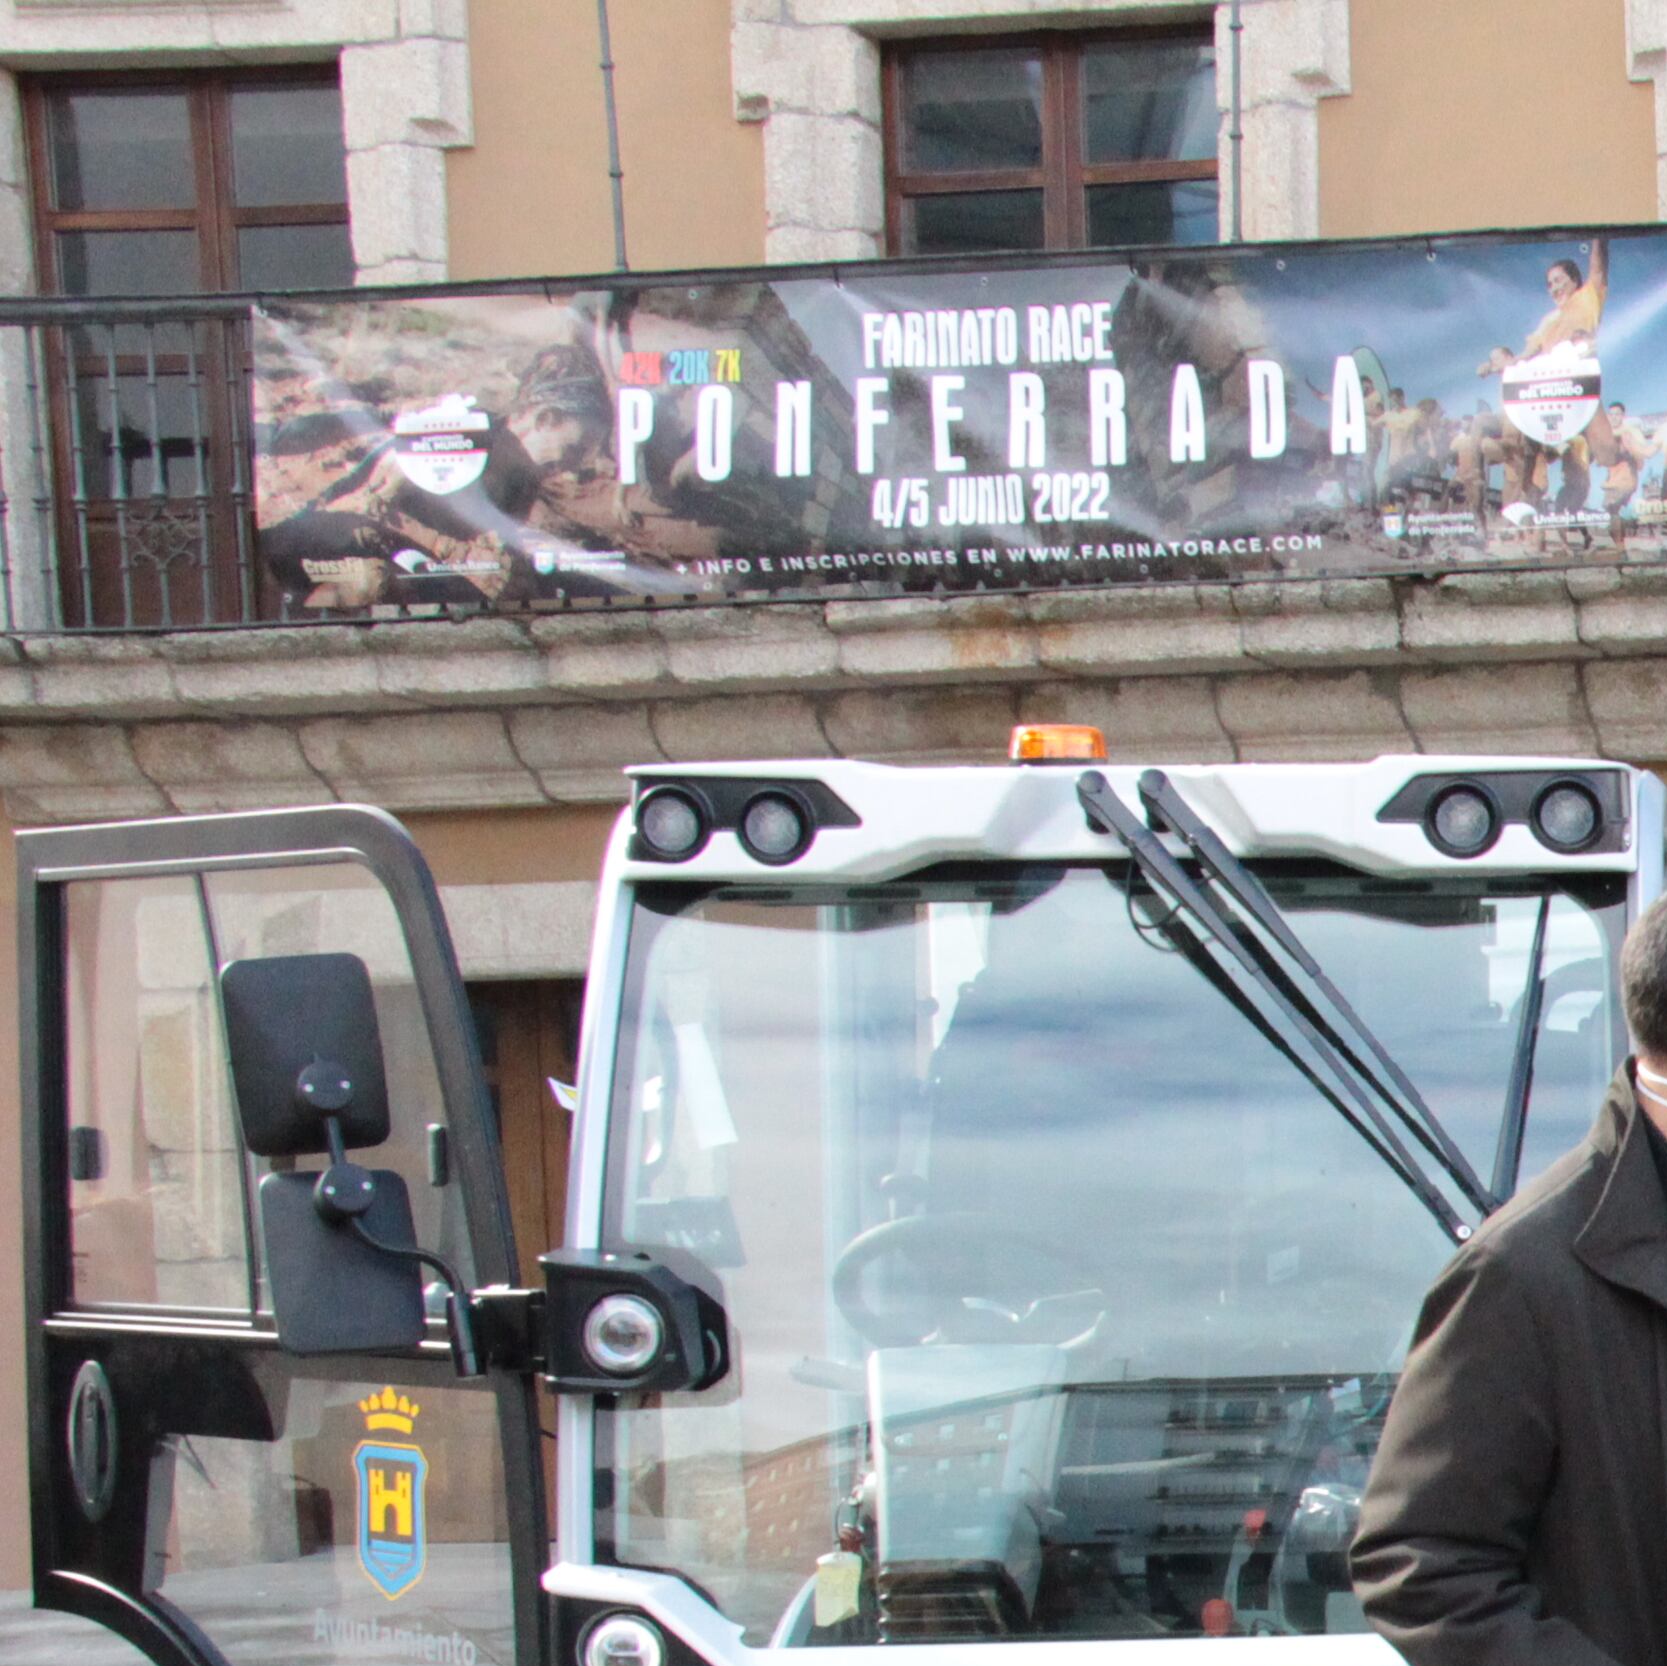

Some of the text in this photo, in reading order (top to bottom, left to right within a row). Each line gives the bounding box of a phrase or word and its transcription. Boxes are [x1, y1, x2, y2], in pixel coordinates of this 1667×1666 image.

[862, 302, 1114, 369] FARINATO RACE
[620, 348, 741, 385] 42K 20K 7K
[617, 355, 1368, 486] PONFERRADA
[872, 471, 1111, 529] 4/5 JUNIO 2022
[697, 557, 752, 576] INFO
[761, 556, 774, 573] E
[781, 549, 958, 572] INSCRIPCIONES
[966, 548, 998, 565] EN
[1008, 535, 1324, 564] WWW.FARINATORACE.COM
